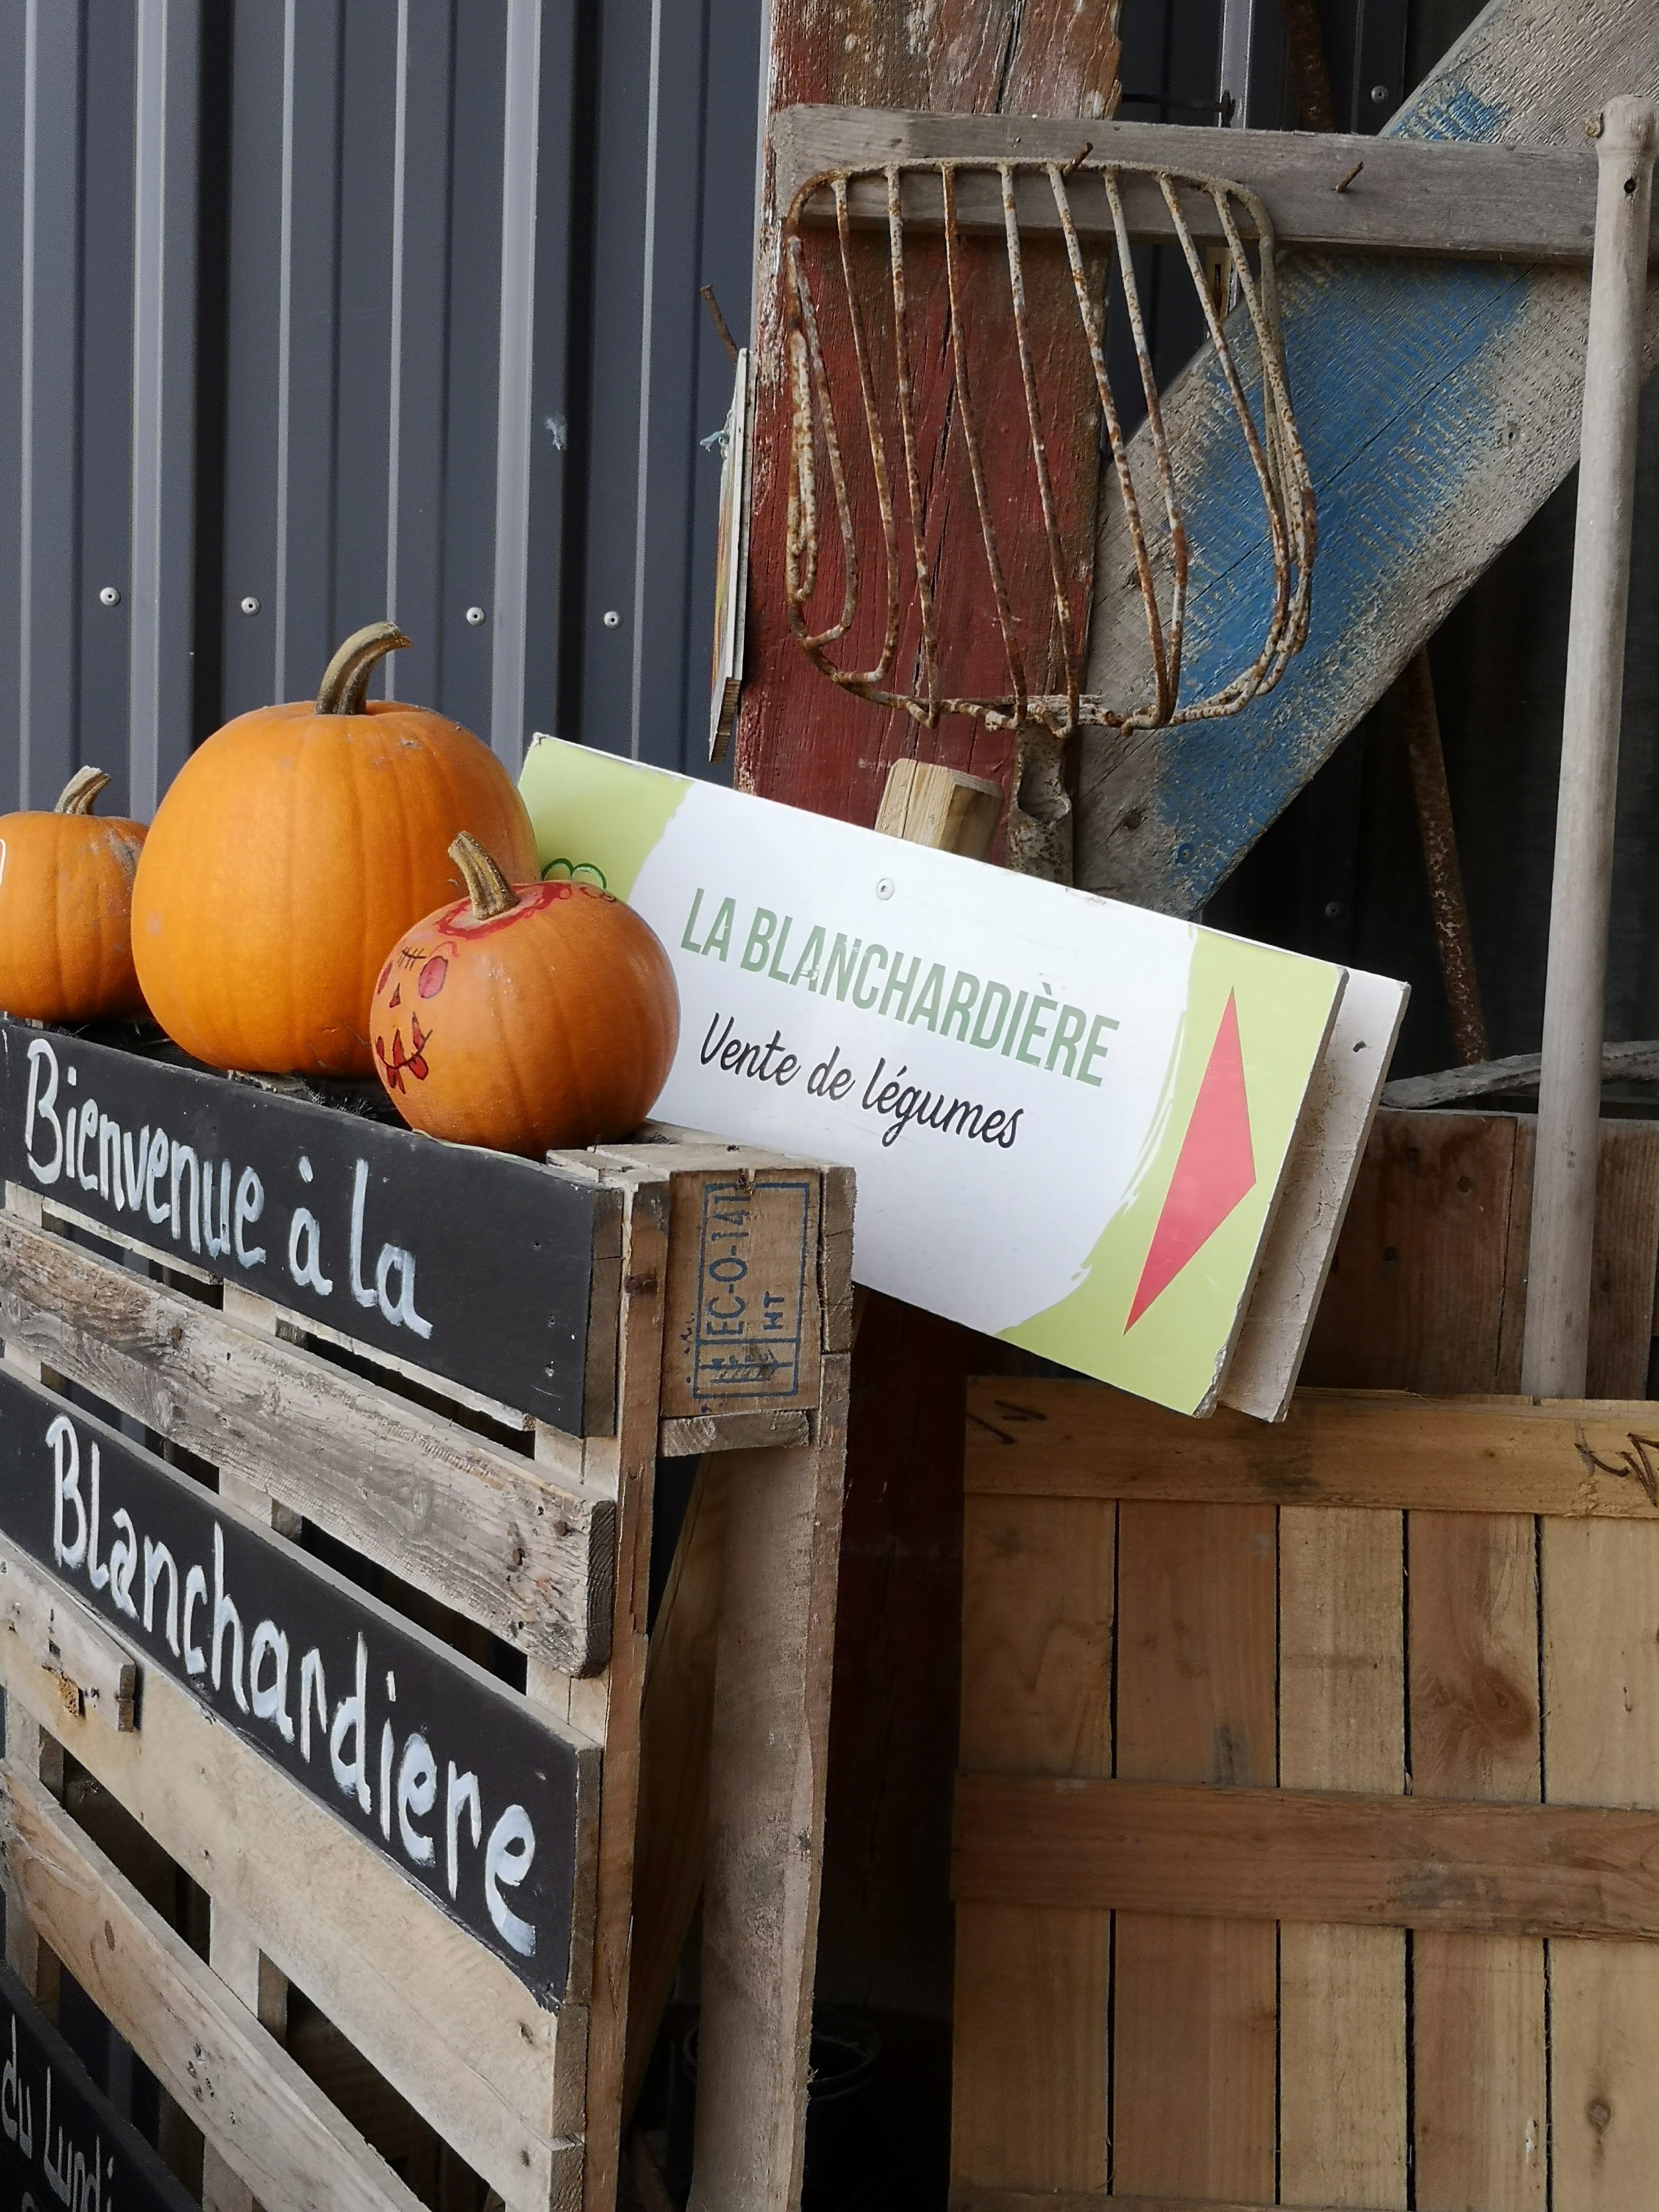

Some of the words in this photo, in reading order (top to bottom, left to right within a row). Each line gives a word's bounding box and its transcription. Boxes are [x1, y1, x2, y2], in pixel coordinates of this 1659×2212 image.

[680, 888, 737, 962] LA
[740, 906, 1120, 1088] BLANCHARDIÈRE
[700, 1012, 802, 1086] Vente
[807, 1046, 855, 1101] de
[862, 1057, 1025, 1149] légumes
[25, 1037, 266, 1269] Bienvenue
[289, 1156, 333, 1296] à
[350, 1158, 433, 1340] la
[764, 1291, 785, 1331] HT
[2, 2013, 32, 2160] du
